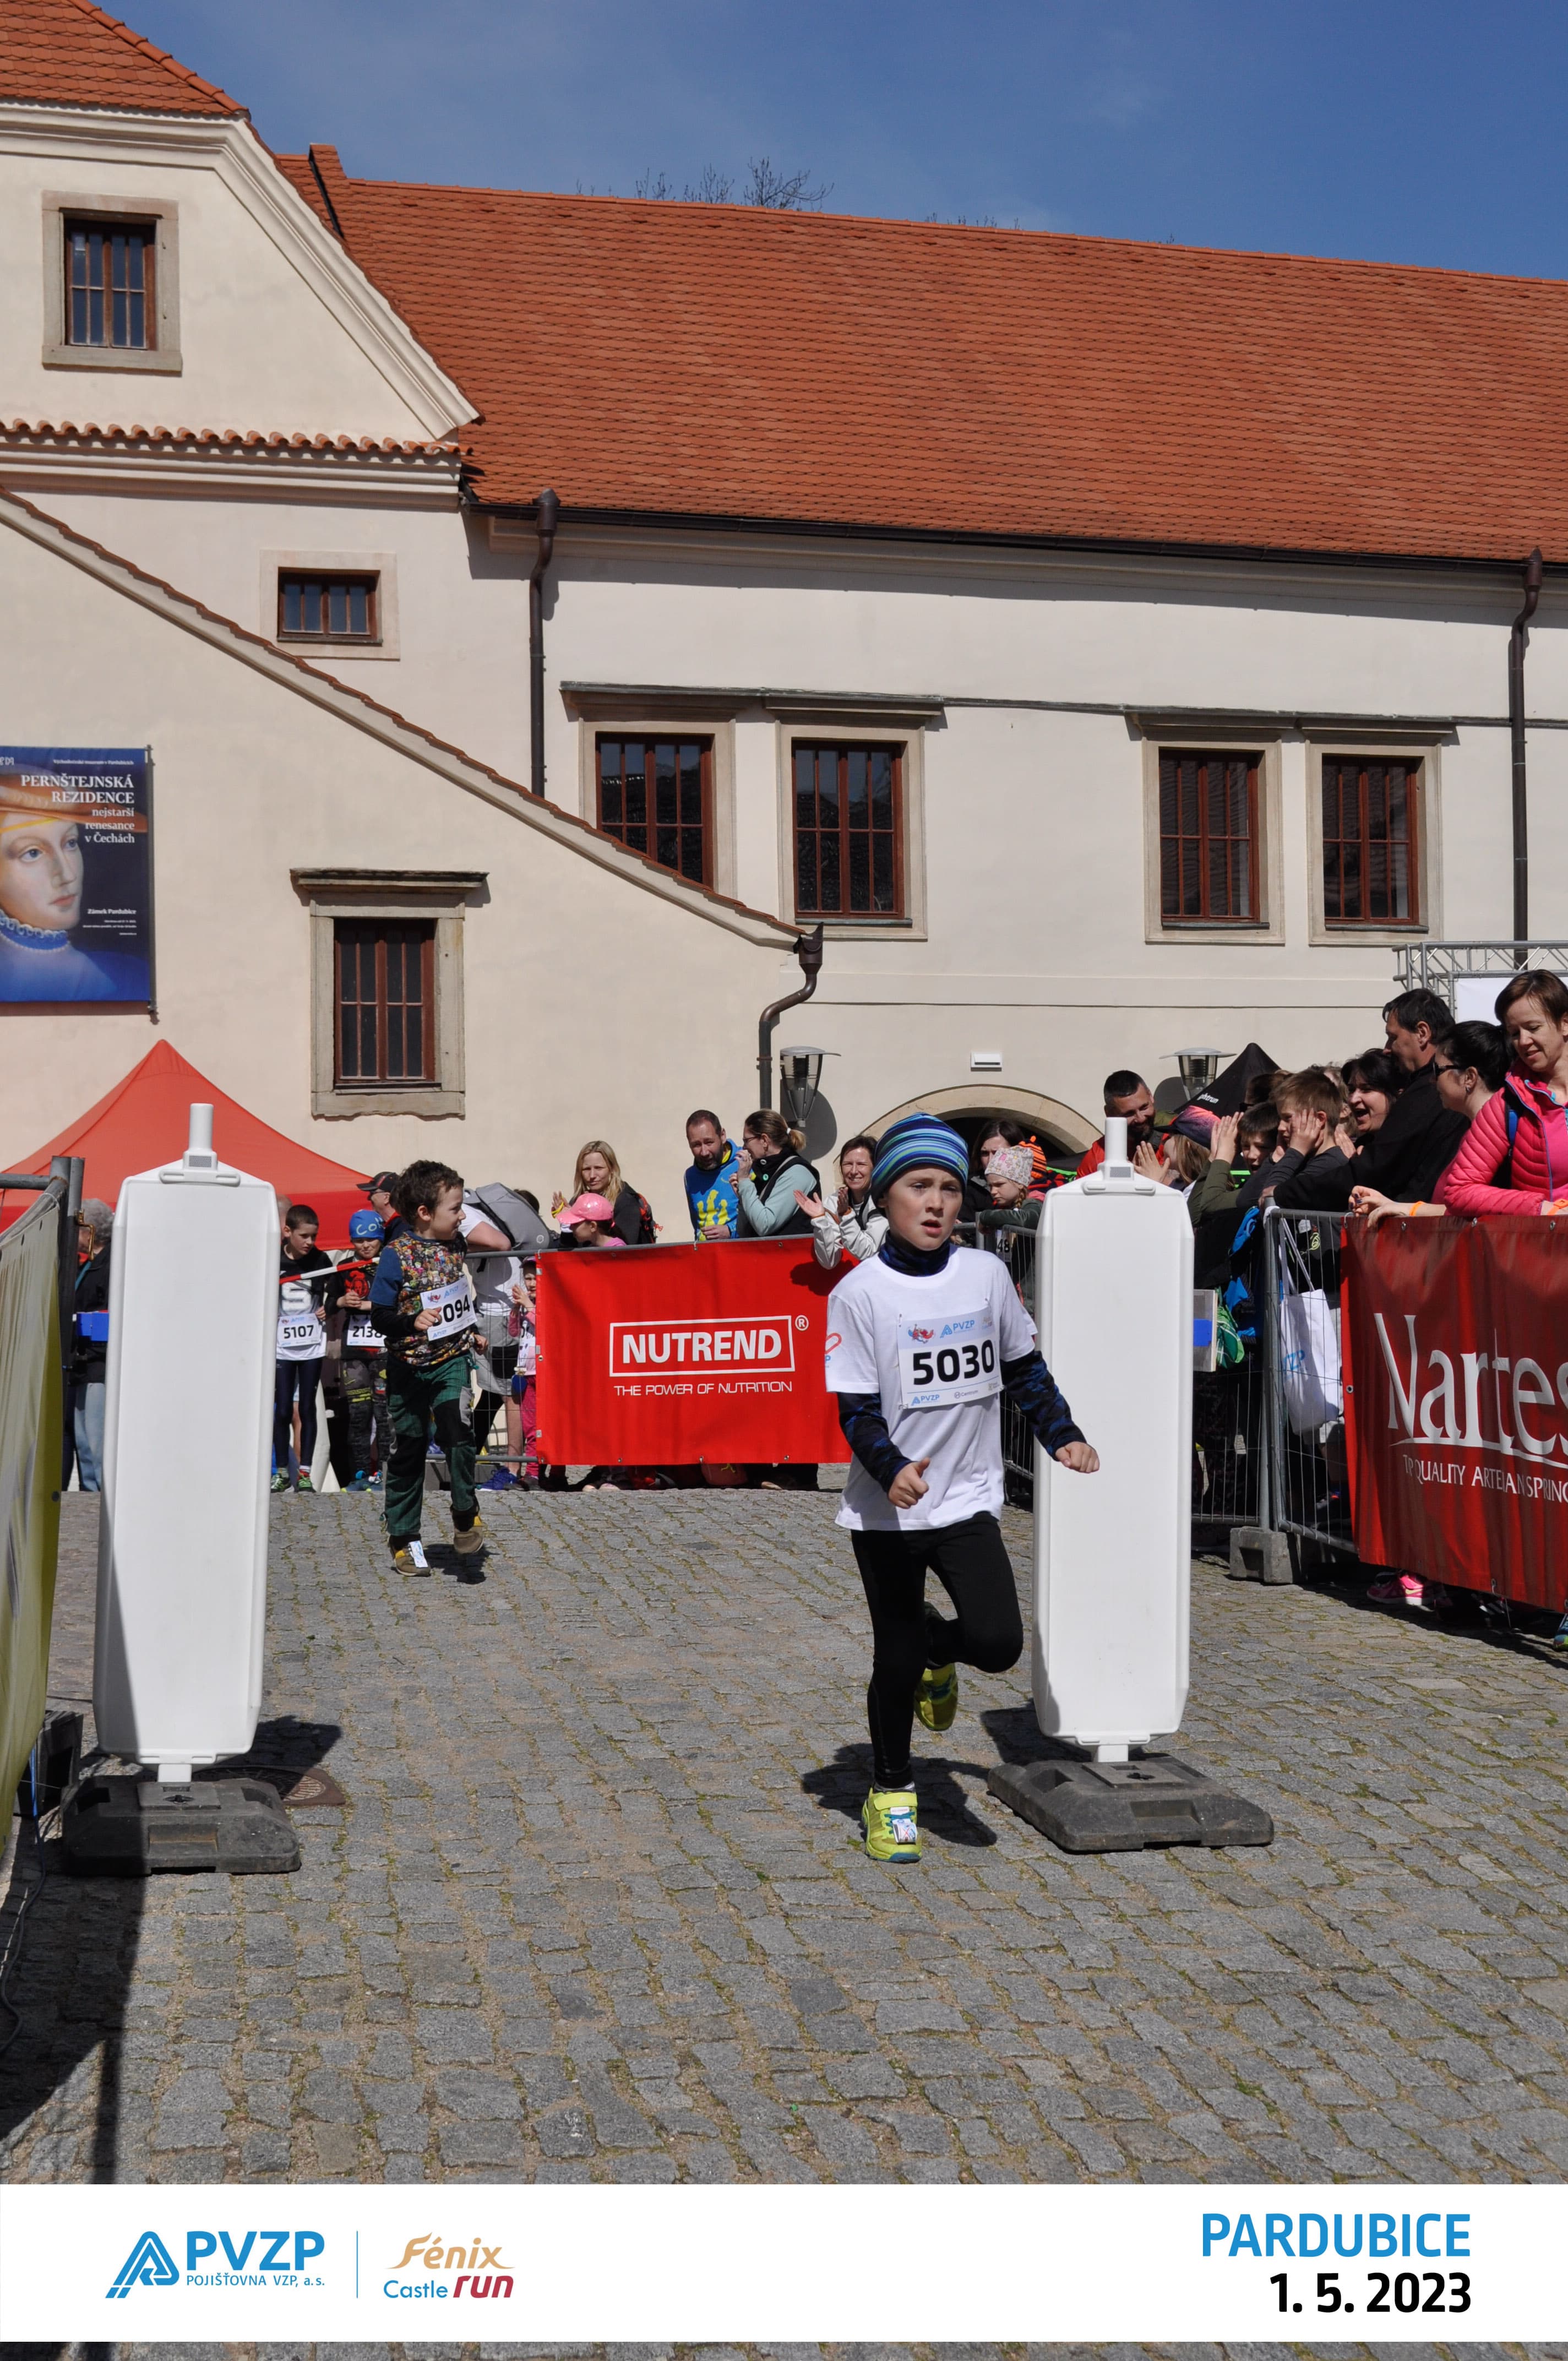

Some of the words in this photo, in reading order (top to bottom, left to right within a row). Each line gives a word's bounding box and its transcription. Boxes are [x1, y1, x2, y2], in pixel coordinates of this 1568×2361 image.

[21, 773, 134, 788] PERNŠTEJNSKÁ
[52, 791, 134, 803] REZIDENCE
[92, 808, 134, 818] nejstarší
[94, 831, 135, 843] Čechách
[284, 1325, 314, 1339] 5107
[953, 1320, 974, 1330] PVZP
[623, 1329, 782, 1364] NUTREND
[913, 1339, 994, 1385] 5030
[614, 1385, 641, 1396] THE
[646, 1384, 693, 1395] POWER
[697, 1383, 715, 1394] OF
[718, 1381, 792, 1393] NUTRITION
[1415, 1460, 1465, 1485] QUALITY
